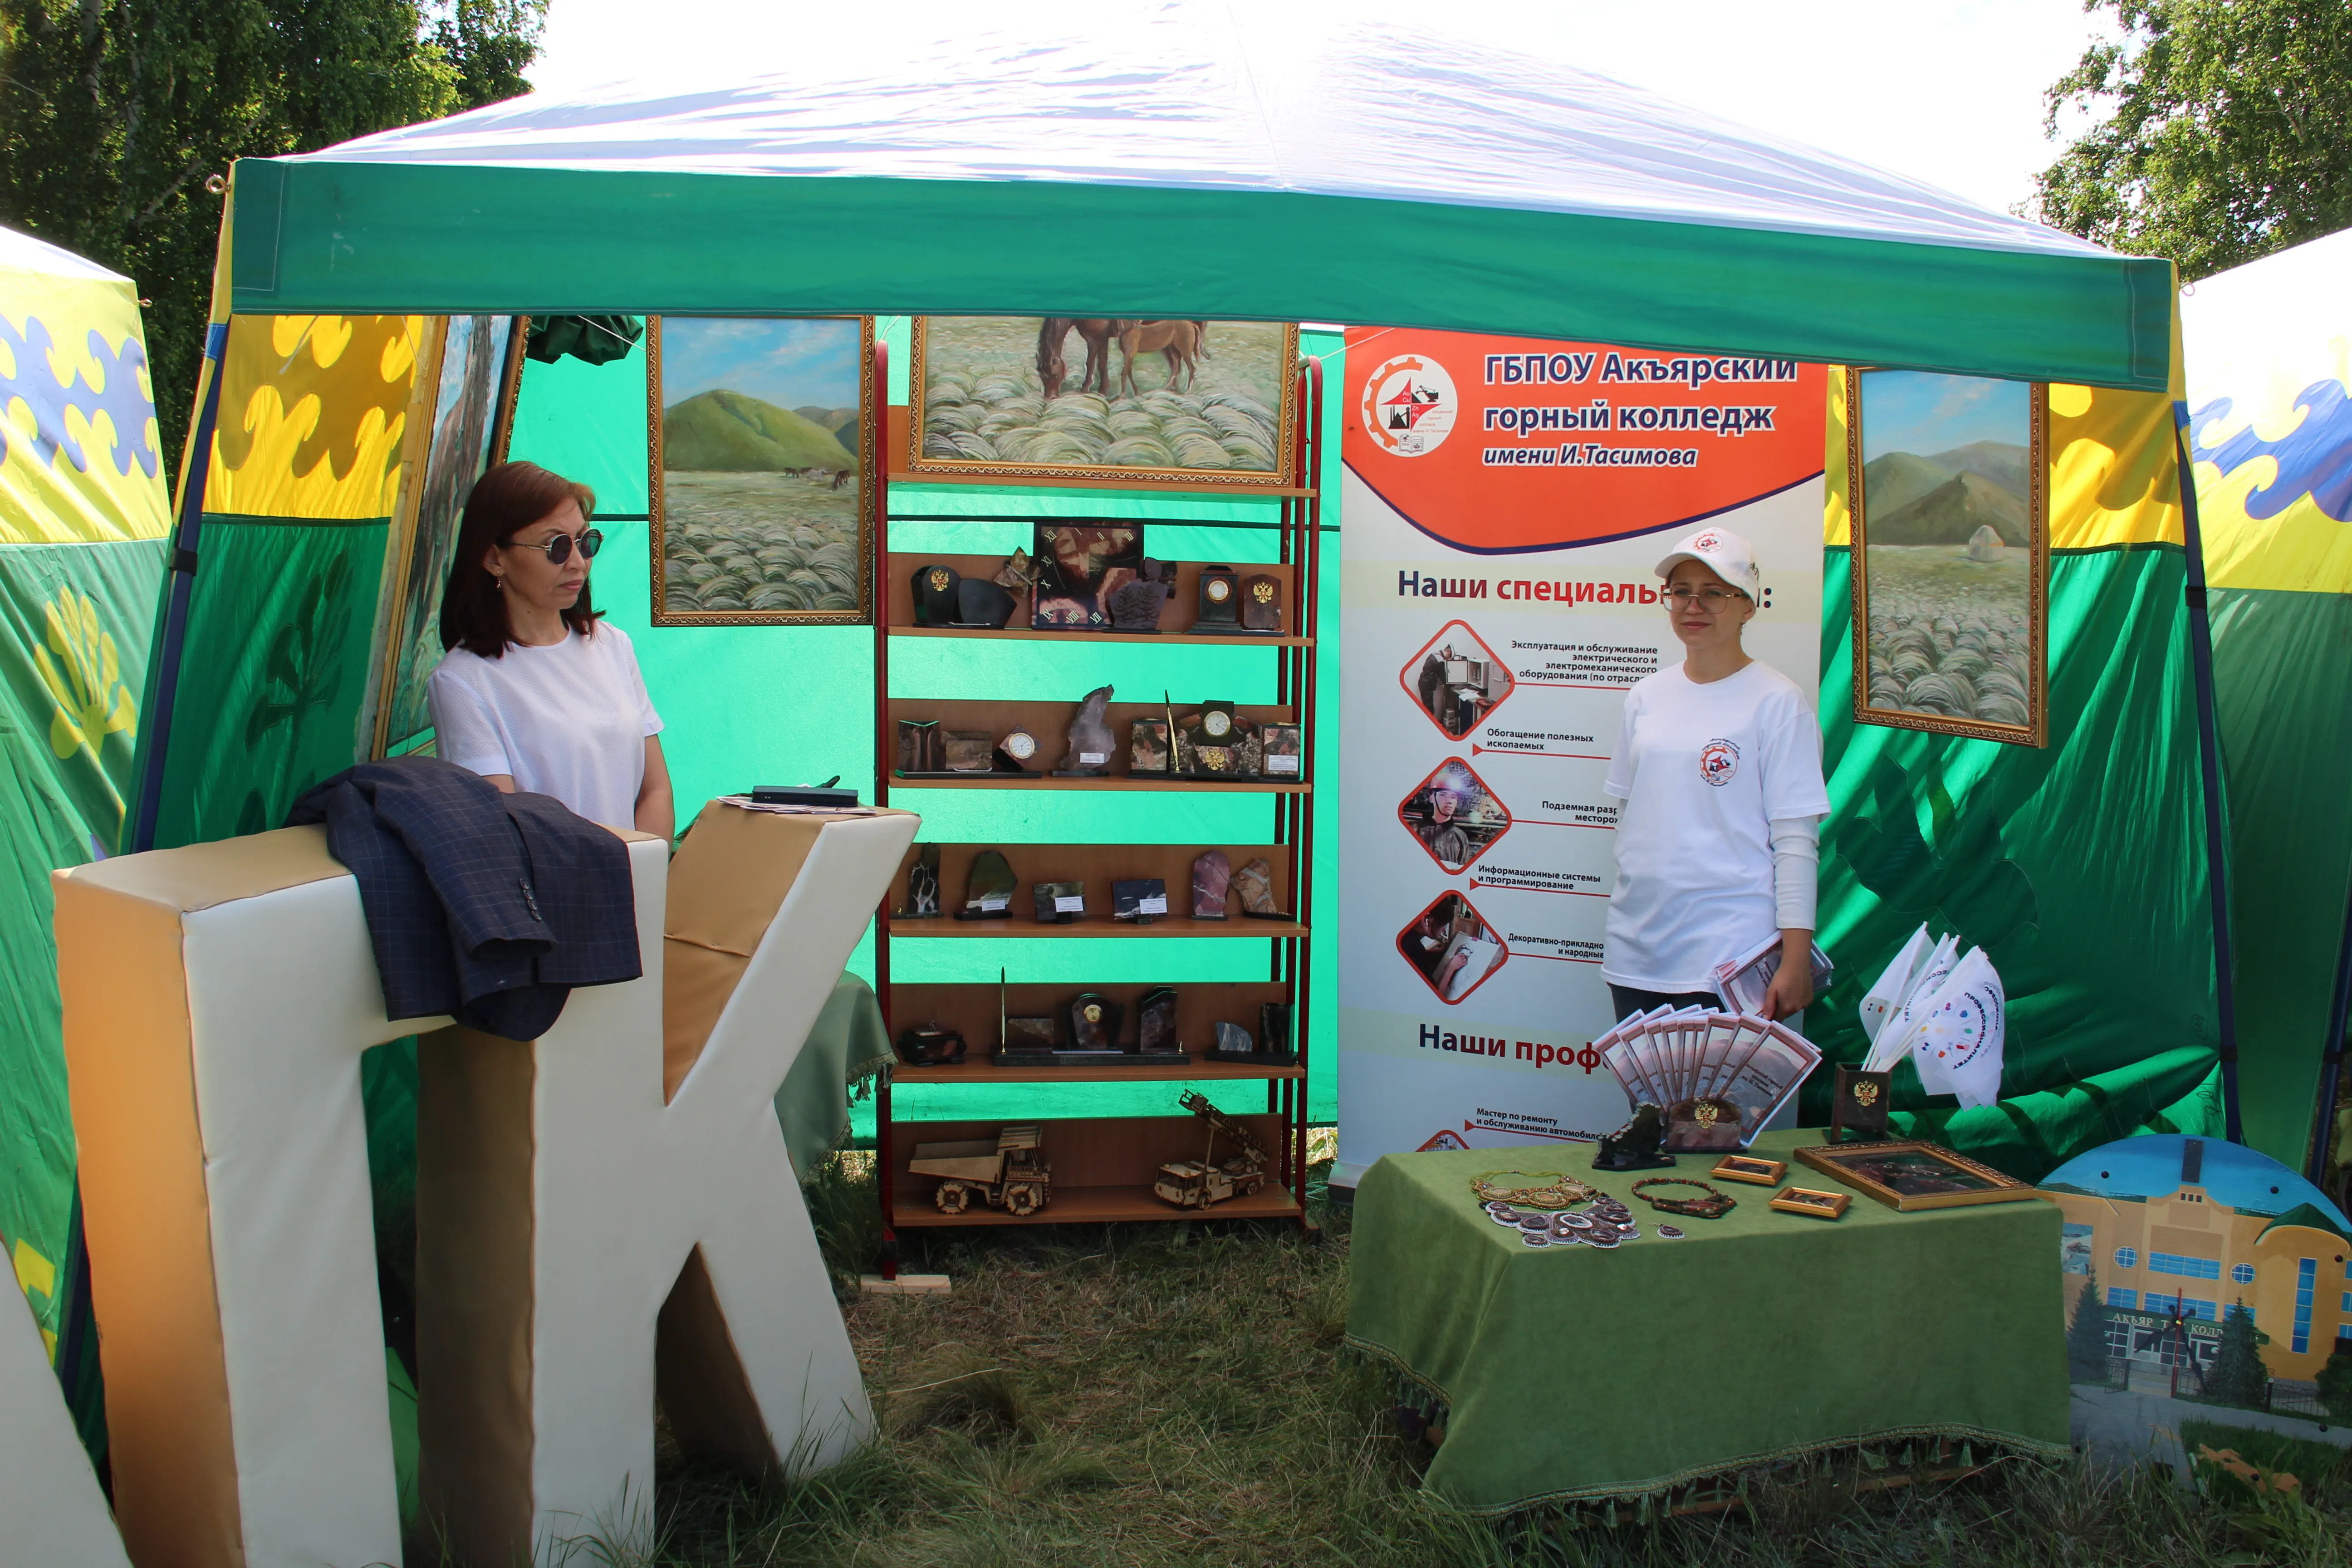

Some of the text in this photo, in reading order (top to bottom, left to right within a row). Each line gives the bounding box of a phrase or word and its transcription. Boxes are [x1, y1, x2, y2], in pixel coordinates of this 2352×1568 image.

[1485, 353, 1798, 390] ГБПОУ Акъярский
[1485, 400, 1776, 436] горный колледж
[1483, 445, 1698, 467] имени И.Тасимова
[1044, 530, 1057, 543] XII
[1124, 531, 1134, 542] III
[1041, 555, 1053, 567] XI
[1398, 570, 1772, 608] Наши специаль:
[1511, 640, 1576, 653] Эксплуатация
[1586, 643, 1658, 655] обслуживание
[1573, 654, 1648, 664] электрического
[1519, 669, 1588, 681] оборудования
[1590, 673, 1605, 681] (по
[1545, 662, 1657, 674] электромеханического
[1487, 728, 1594, 743] Обогащение полезных
[1487, 741, 1545, 751] ископаемых
[1542, 801, 1595, 812] Подземная
[1478, 865, 1601, 883] Информационные системы
[1485, 877, 1574, 891] программирование
[1508, 933, 1604, 950] Декоративно-прикладно
[1565, 949, 1604, 959] народные
[1419, 1023, 1610, 1075] Наши проф
[1476, 1107, 1507, 1119] Мастер
[1521, 1114, 1558, 1126] ремонту
[1484, 1118, 1547, 1133] обслуживанию
[2113, 1312, 2153, 1327] АКЪЯР
